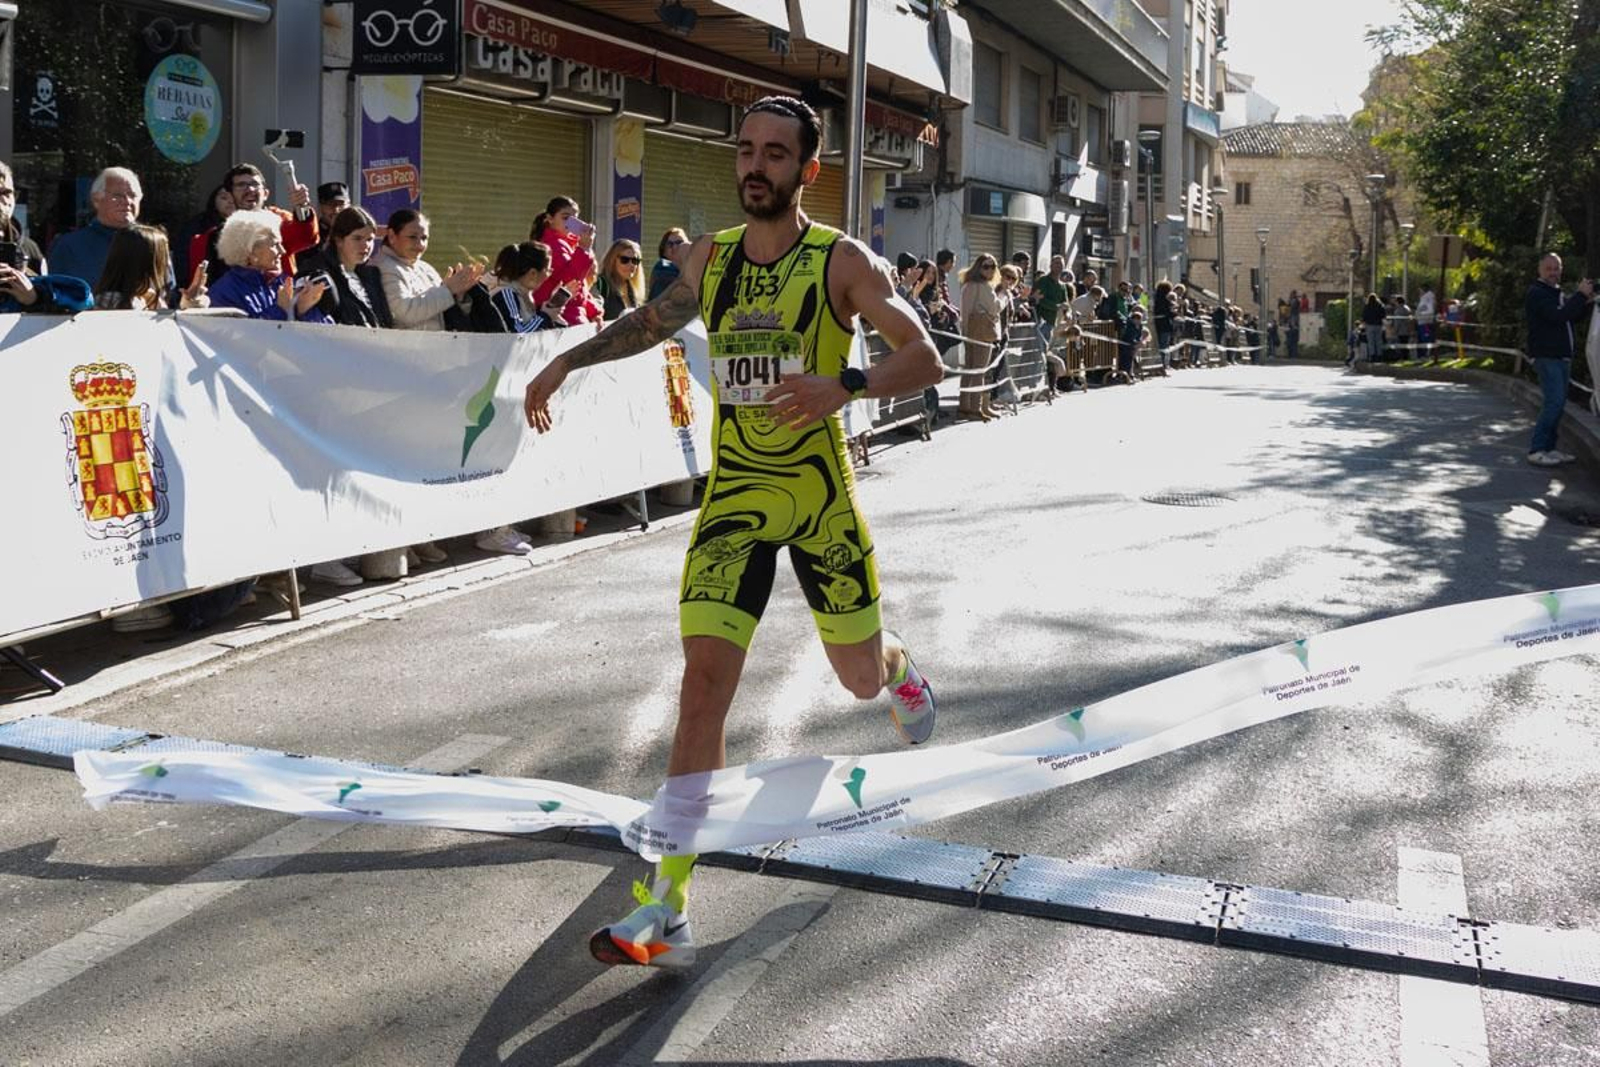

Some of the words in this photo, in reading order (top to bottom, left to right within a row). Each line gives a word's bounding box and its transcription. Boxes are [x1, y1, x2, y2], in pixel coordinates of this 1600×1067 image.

[472, 3, 515, 37] Casa
[520, 17, 557, 48] Paco
[370, 172, 393, 187] Casa
[393, 169, 414, 184] Paco
[735, 274, 779, 298] 1153
[727, 356, 780, 386] 1041
[1516, 634, 1559, 648] Deportes
[1561, 631, 1574, 640] de
[1305, 666, 1347, 683] Municipal
[1348, 664, 1360, 673] de
[1276, 686, 1316, 701] Deportes
[1317, 682, 1328, 690] de
[1051, 754, 1089, 771] Deportes
[816, 813, 857, 830] Patronato
[857, 800, 899, 819] Municipal
[899, 795, 911, 805] de
[871, 815, 882, 824] de
